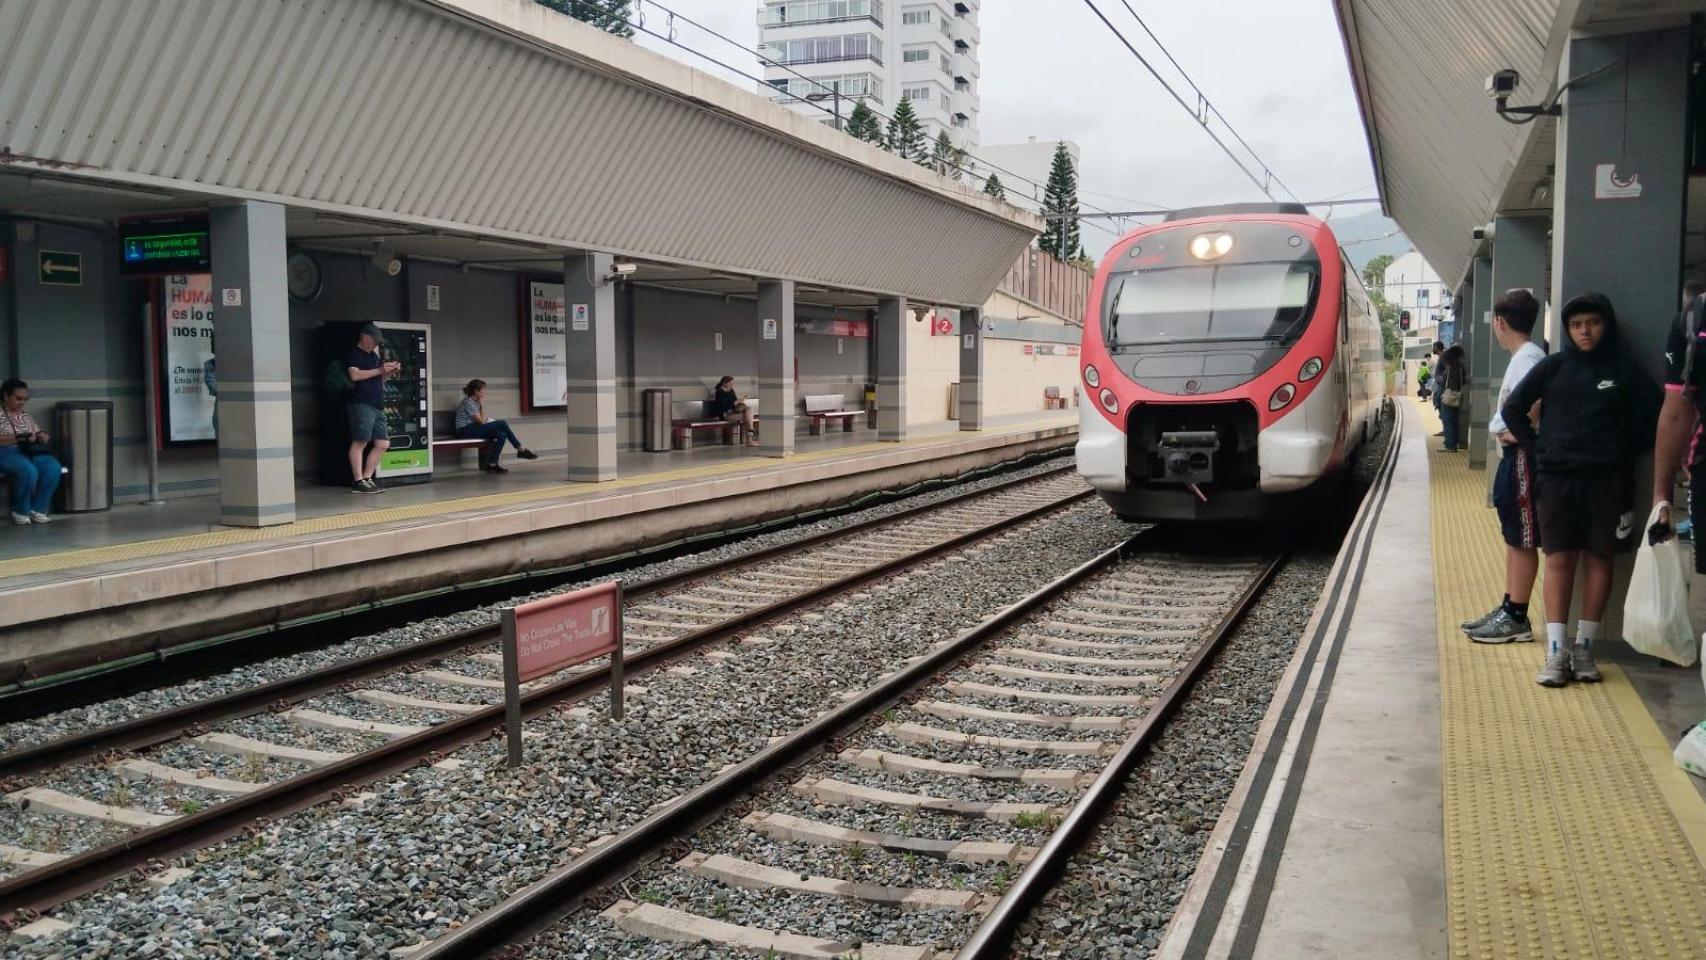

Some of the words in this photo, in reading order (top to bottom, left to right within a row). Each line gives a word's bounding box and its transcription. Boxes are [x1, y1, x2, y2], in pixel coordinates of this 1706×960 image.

[171, 288, 214, 304] HUMA
[171, 309, 188, 320] es
[191, 305, 203, 321] lo
[172, 326, 197, 337] nos
[941, 320, 949, 331] 2
